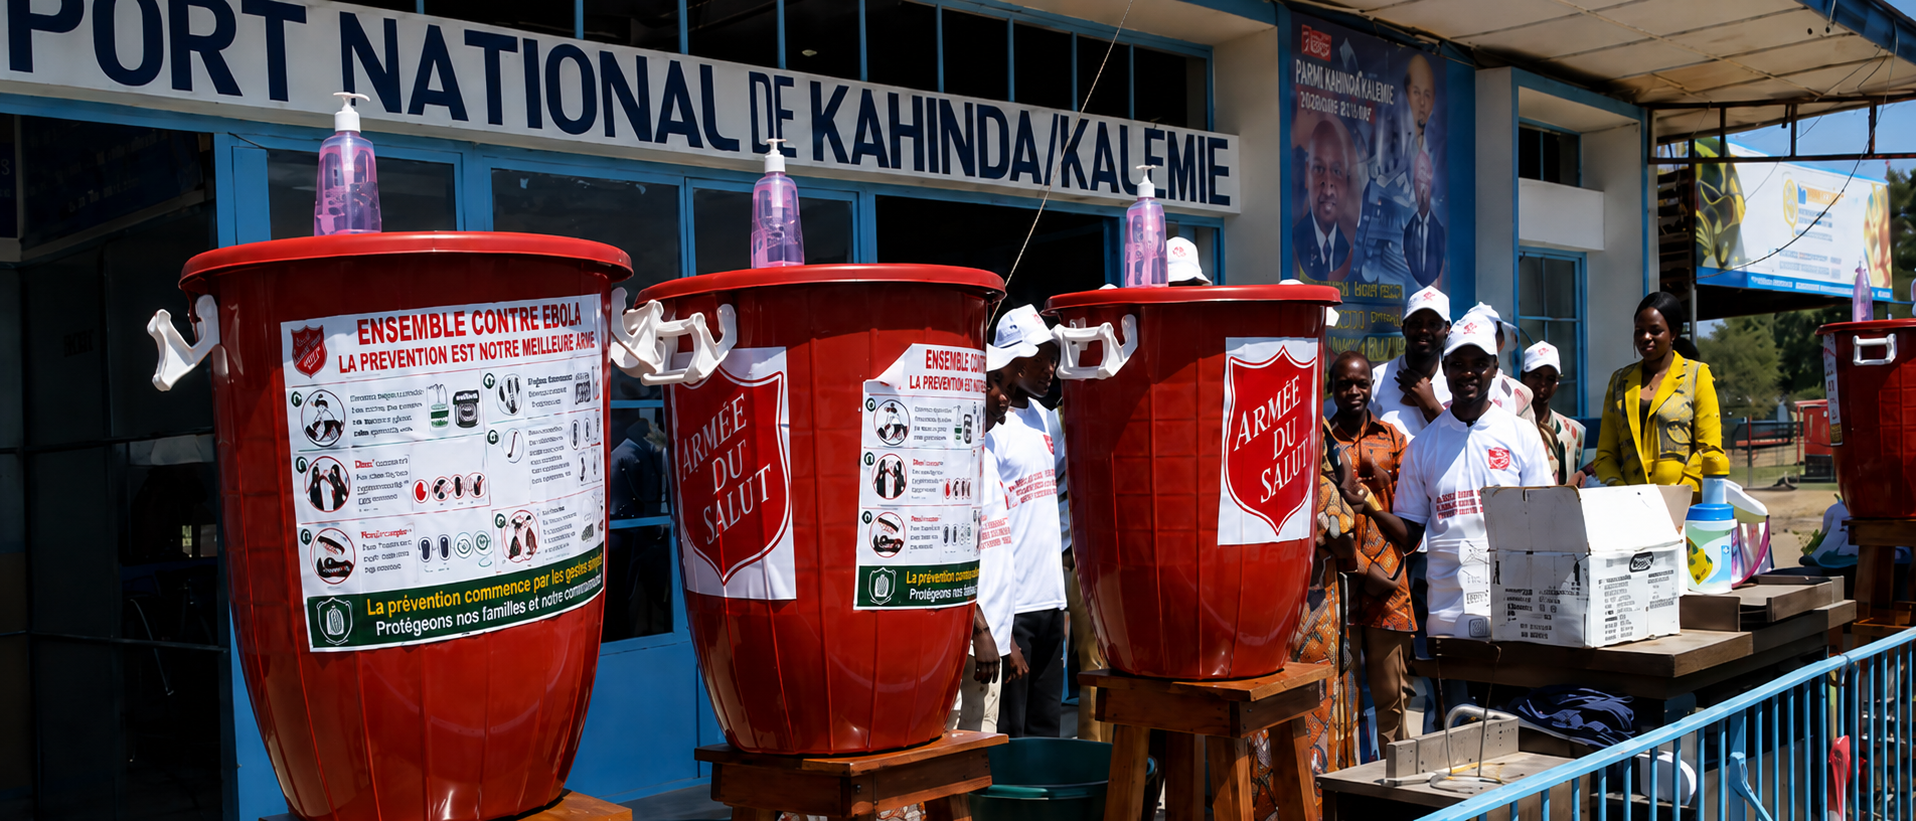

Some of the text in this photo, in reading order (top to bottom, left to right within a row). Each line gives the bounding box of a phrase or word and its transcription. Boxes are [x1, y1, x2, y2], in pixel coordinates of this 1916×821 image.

[7, 0, 307, 102] PORT
[339, 10, 740, 153] NATIONAL
[748, 71, 798, 158] DE
[357, 301, 582, 345] ENSEMBLE CONTRE EBOLA
[338, 354, 357, 374] LA
[360, 347, 448, 372] PREVENTION
[451, 343, 476, 363] EST
[479, 339, 520, 361] NOTRE
[522, 333, 574, 357] MEILLEURE
[925, 349, 969, 372] ENSEMBLE
[909, 374, 921, 389] LA
[923, 375, 963, 391] PREVENTION
[1233, 374, 1301, 452] ARMÉE
[682, 392, 748, 482] ARMÉE
[1272, 416, 1297, 460] DU
[711, 440, 747, 495] DU
[1260, 437, 1308, 504] SALUT
[703, 463, 771, 545] SALUT
[367, 598, 384, 616] La
[388, 587, 462, 618] prévention
[464, 577, 533, 605] commence
[533, 573, 551, 594] par
[551, 568, 564, 585] les
[565, 560, 588, 585] gestes
[906, 570, 917, 584] La
[917, 569, 955, 587] prévention
[909, 587, 951, 603] Protégeons
[952, 587, 963, 598] nos
[375, 612, 453, 636] Protégeons
[456, 611, 479, 626] nos
[482, 600, 526, 622] familles
[528, 595, 540, 611] et
[541, 590, 564, 609] notre
